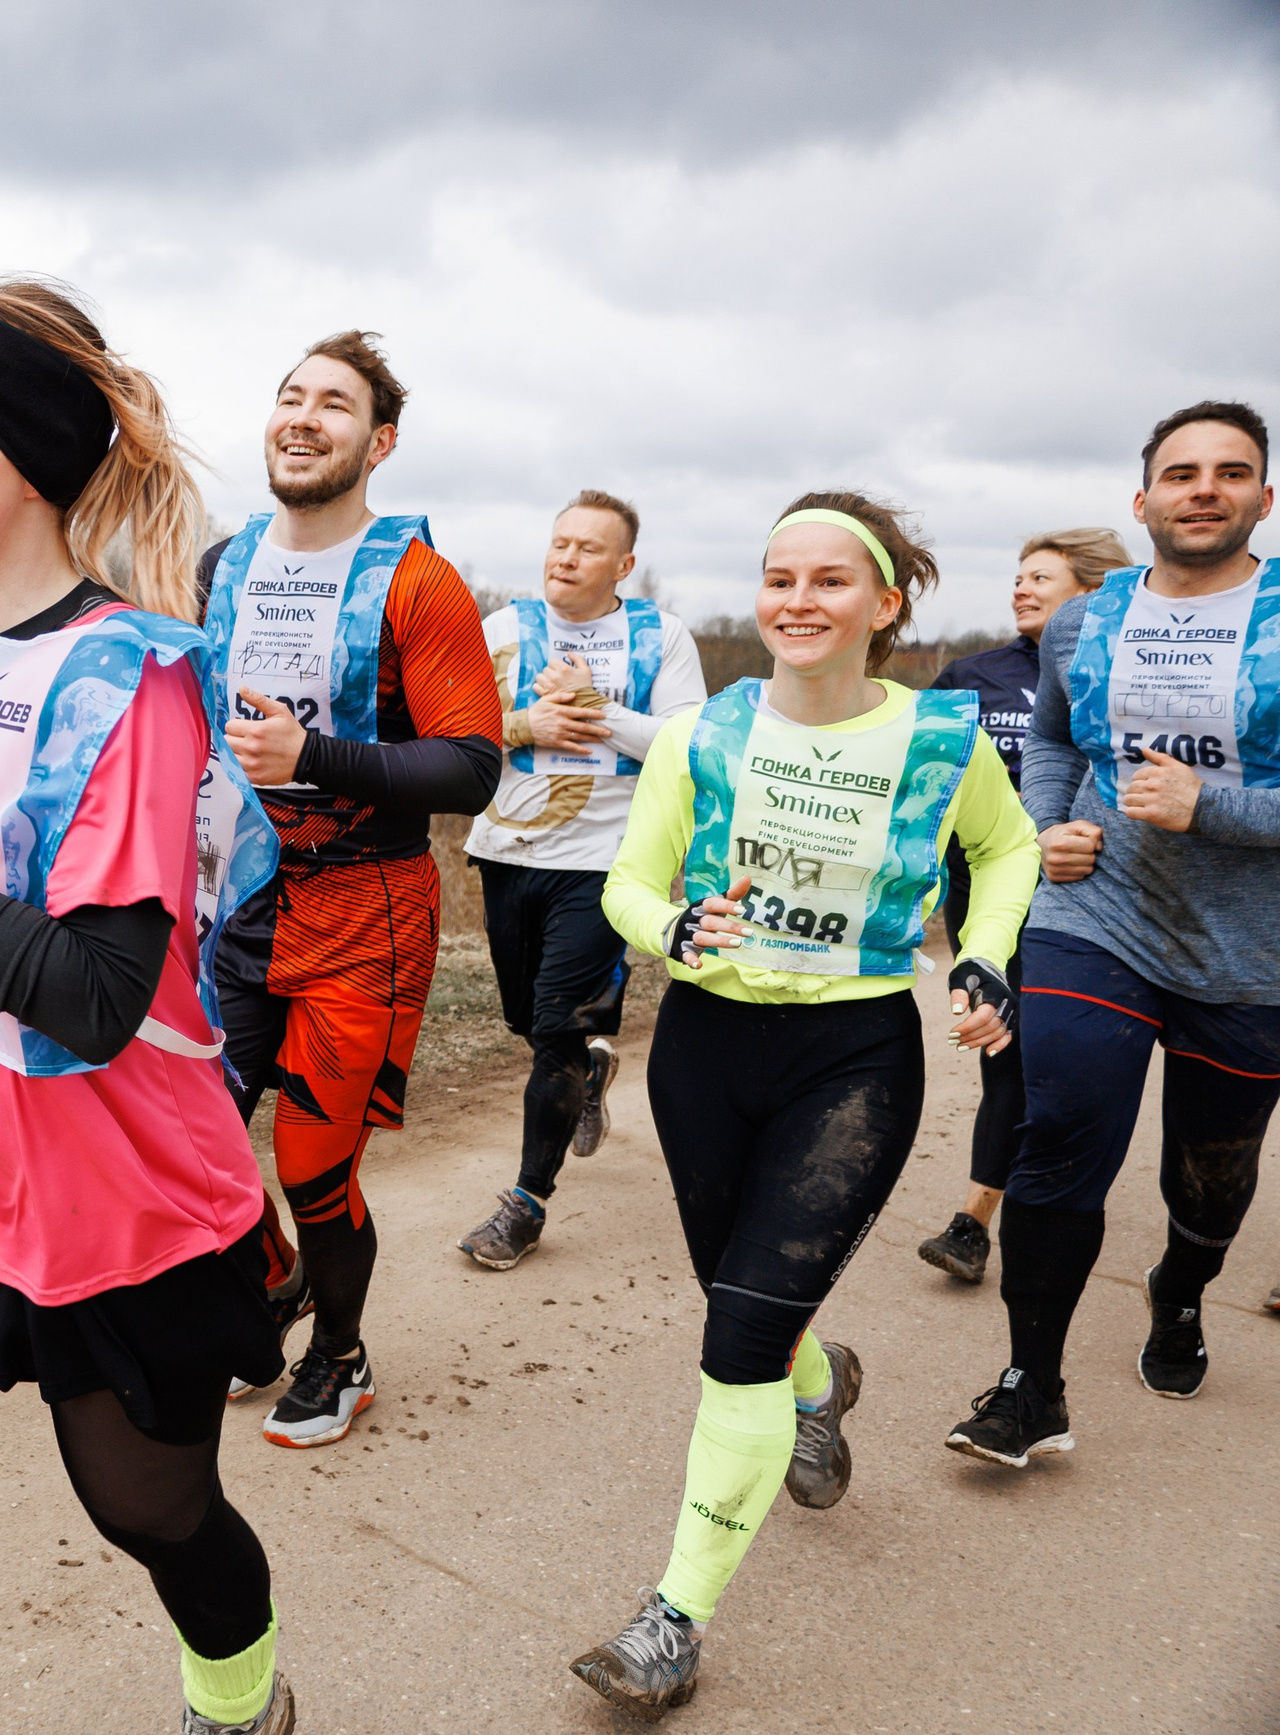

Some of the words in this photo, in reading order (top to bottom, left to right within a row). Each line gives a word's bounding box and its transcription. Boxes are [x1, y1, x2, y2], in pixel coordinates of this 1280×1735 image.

[249, 581, 285, 592] ГОНКА
[288, 582, 338, 594] ГЕРОЕВ
[255, 603, 316, 622] Sminex
[1125, 629, 1171, 639] ГОНКА
[1177, 628, 1237, 640] ГЕРОЕВ
[588, 640, 624, 649] ГЕРОЕВ
[1135, 648, 1214, 666] Sminex
[981, 712, 1032, 728] ГОНК
[751, 756, 812, 781] ГОНКА
[819, 770, 891, 792] ГЕРОЕВ
[764, 785, 864, 825] Sminex
[761, 819, 858, 846] ПЕРФЕКЦИОНИСТЫ
[757, 830, 779, 842] FINE
[782, 837, 854, 858] DEVELOPMENT
[740, 885, 848, 944] 5398
[760, 938, 831, 953] ГАЗПРОМБАНК
